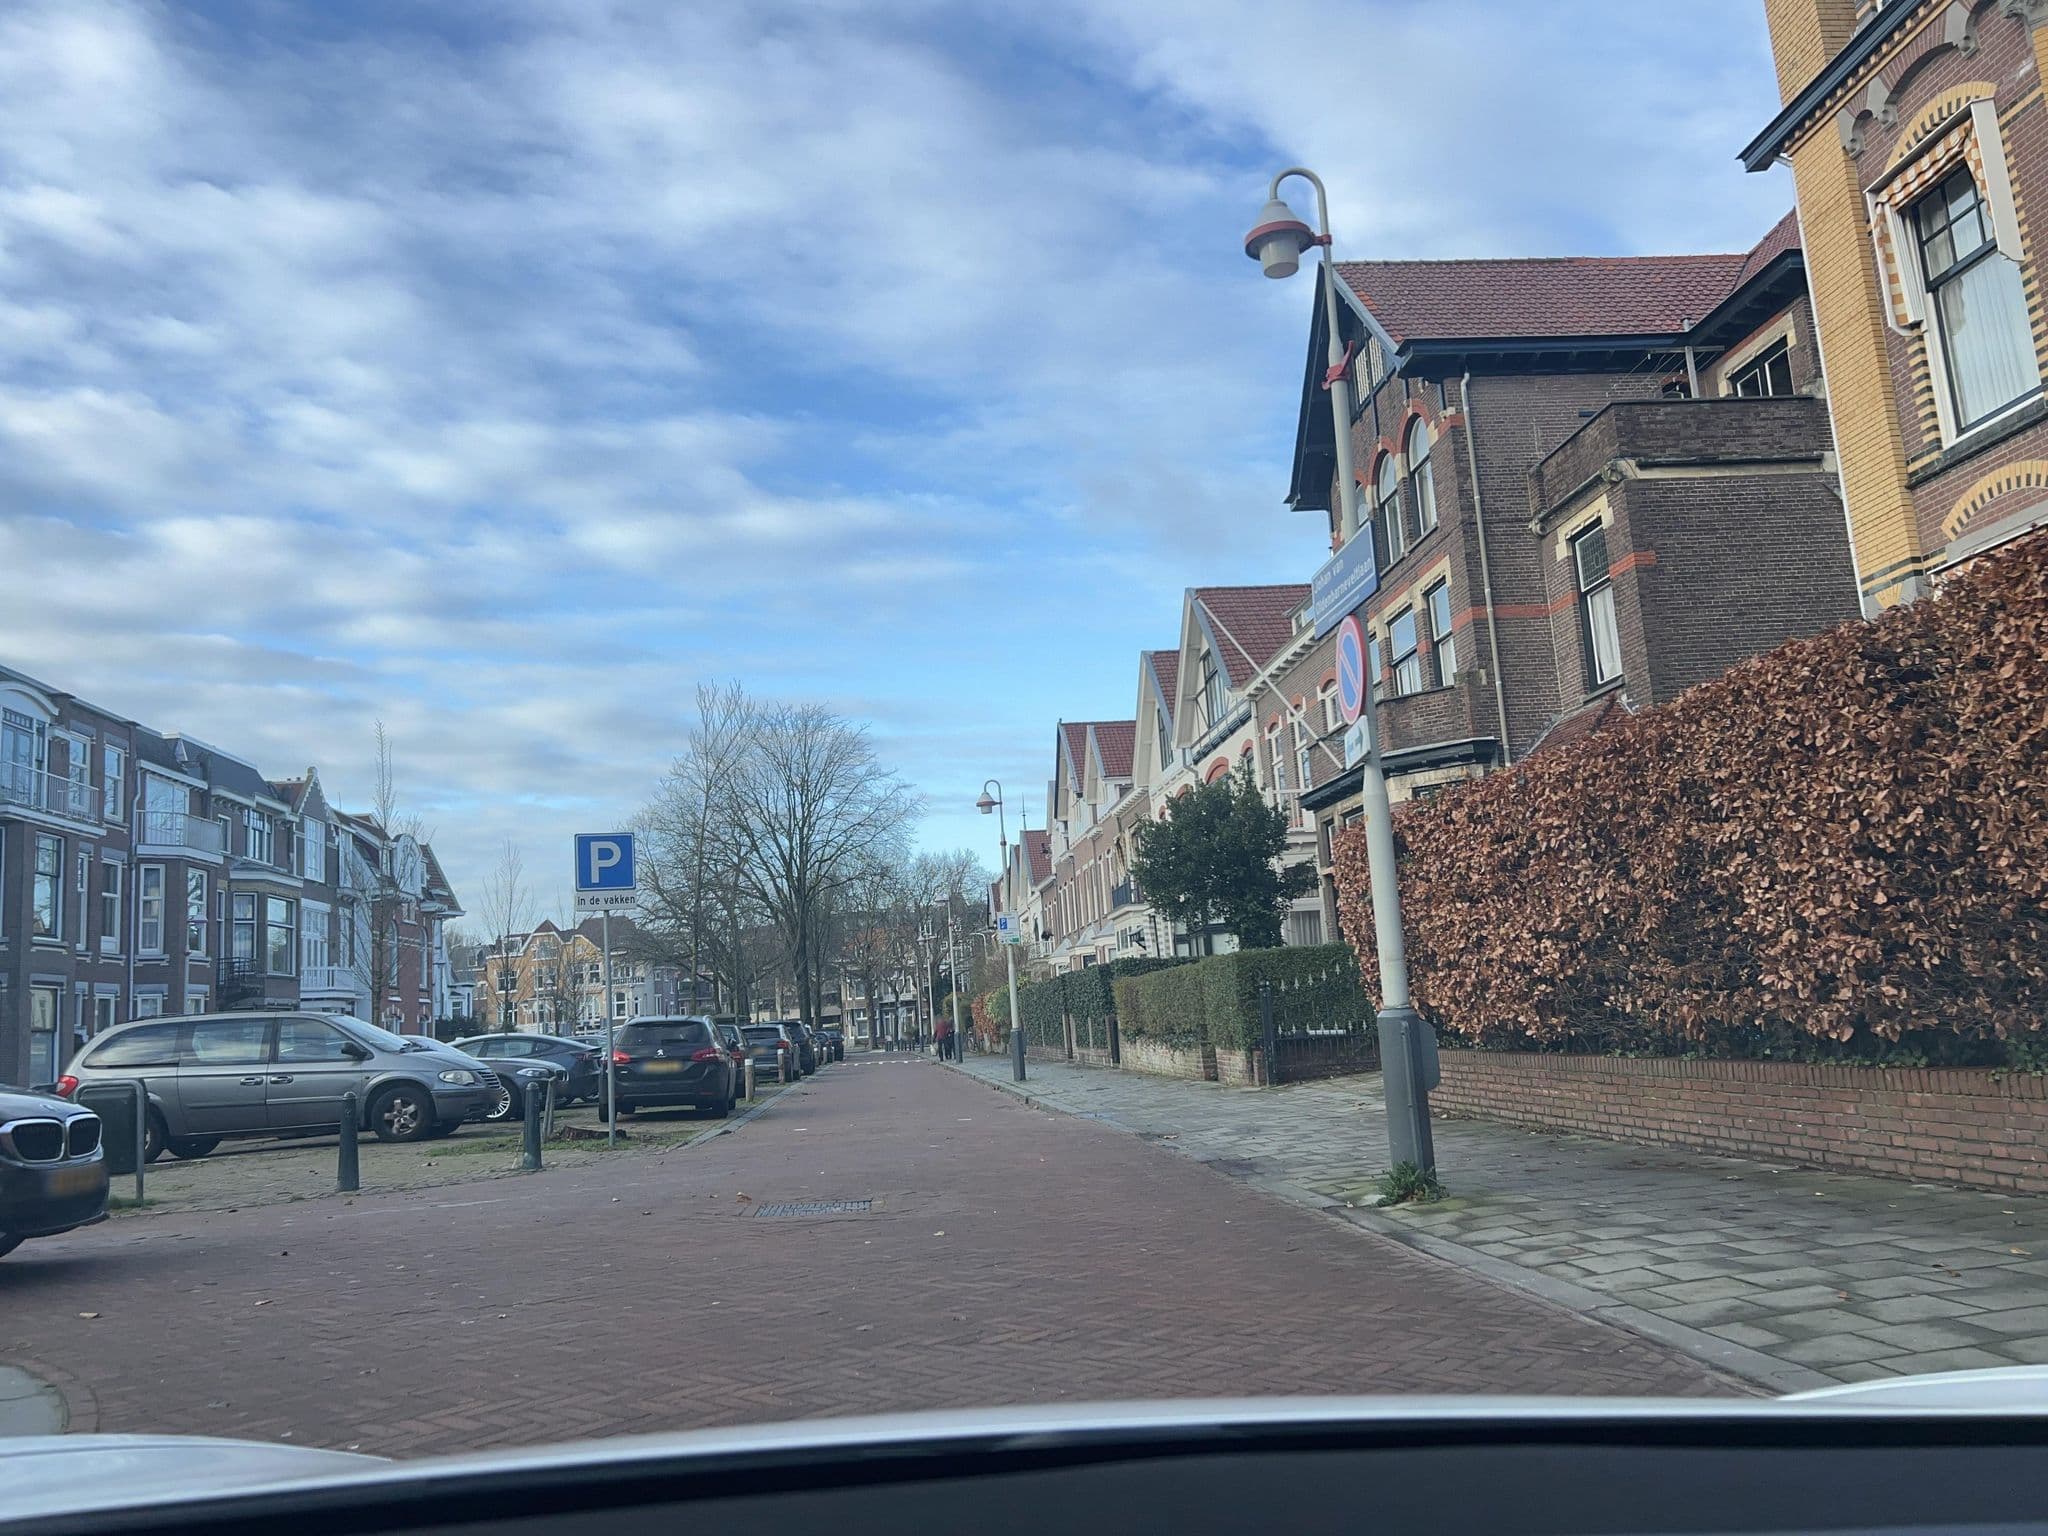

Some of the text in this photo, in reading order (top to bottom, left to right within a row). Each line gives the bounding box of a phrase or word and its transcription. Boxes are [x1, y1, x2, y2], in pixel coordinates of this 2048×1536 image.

[1314, 559, 1344, 594] Johan van
[590, 841, 621, 883] P
[577, 895, 636, 906] in de vakken
